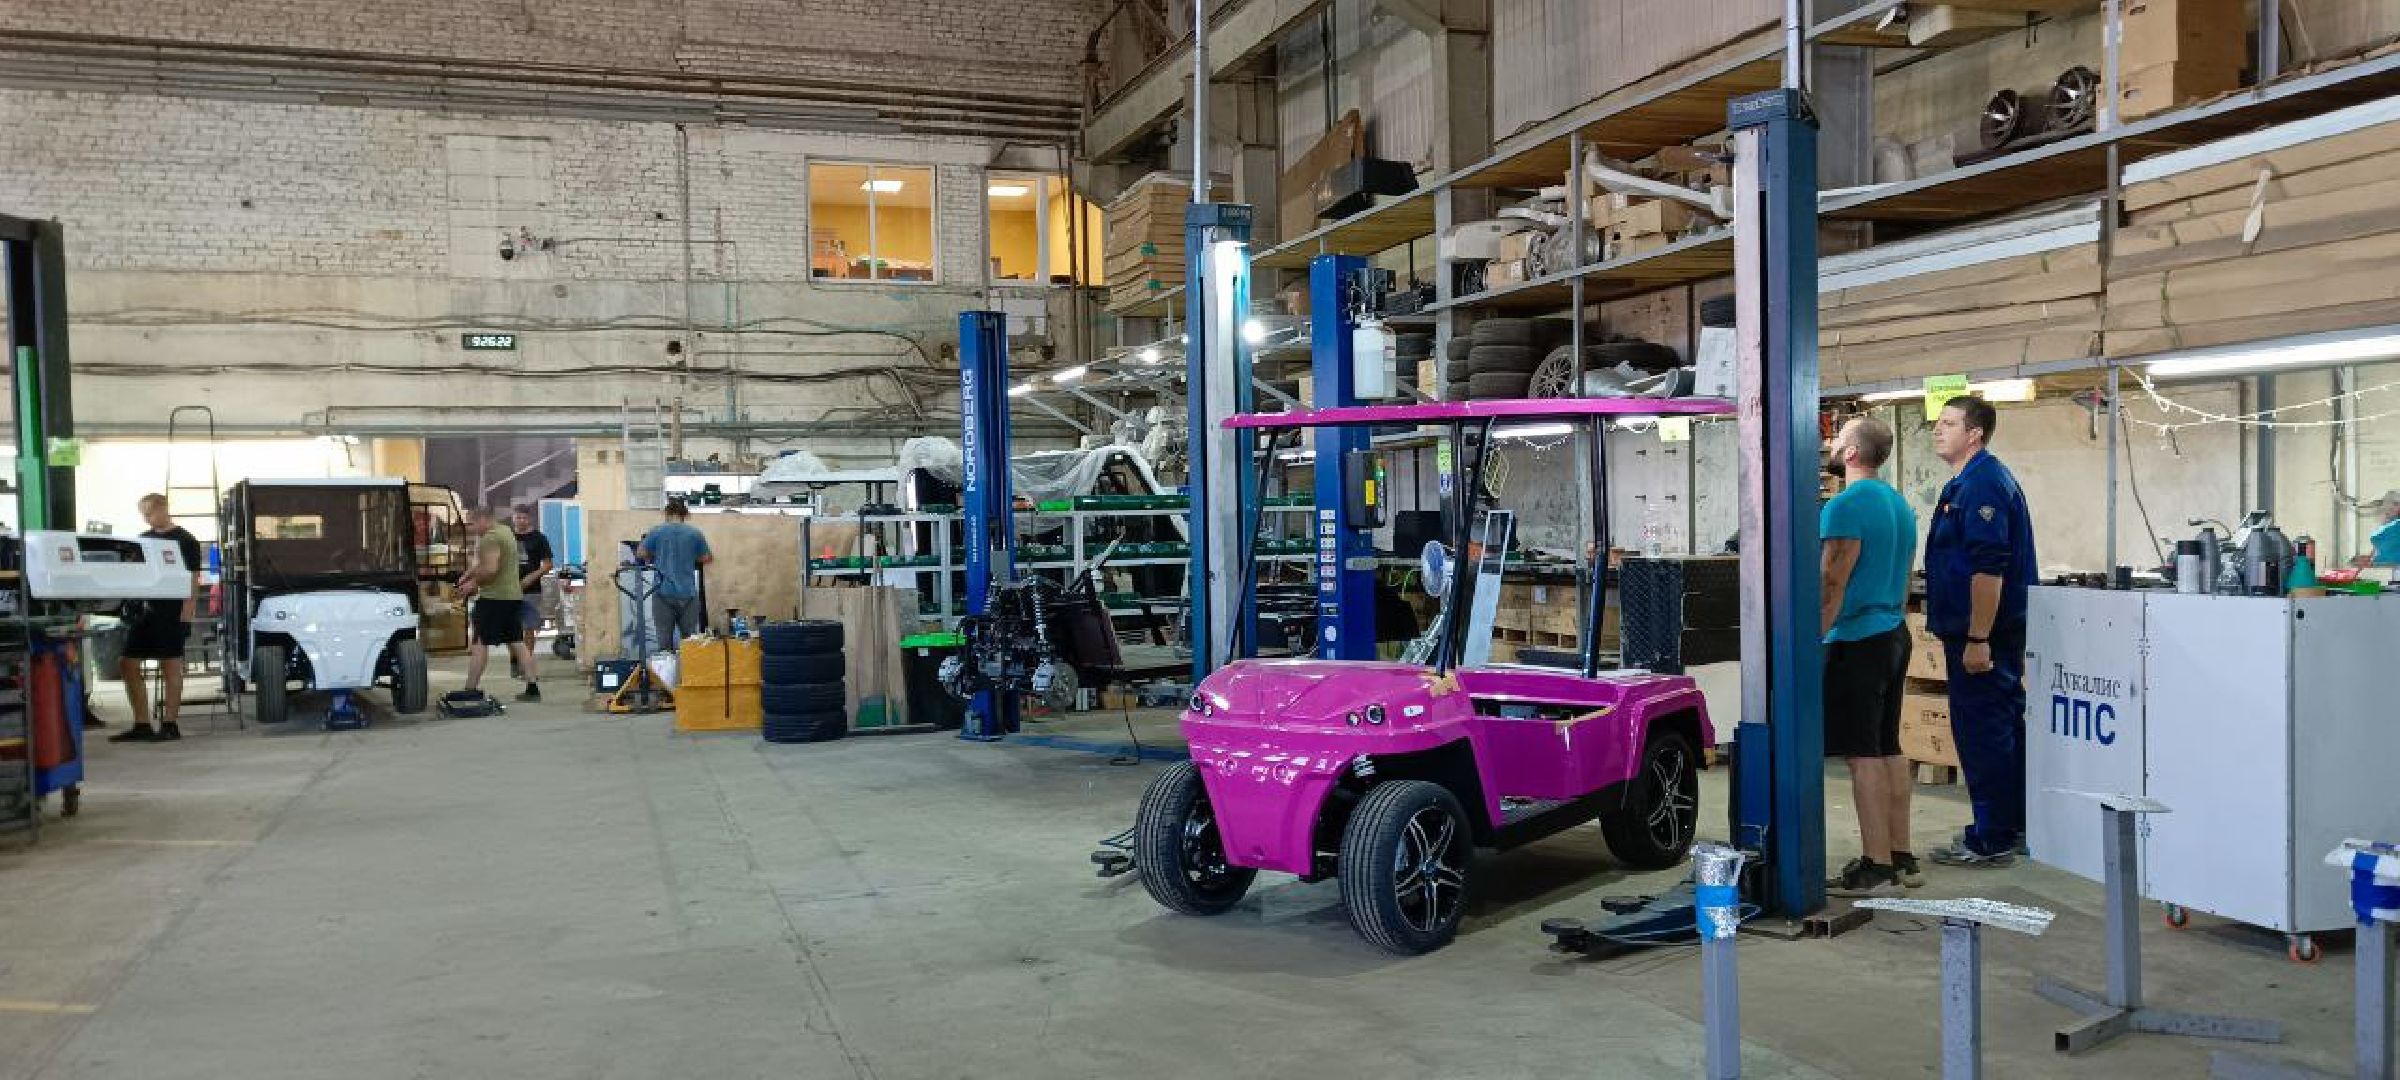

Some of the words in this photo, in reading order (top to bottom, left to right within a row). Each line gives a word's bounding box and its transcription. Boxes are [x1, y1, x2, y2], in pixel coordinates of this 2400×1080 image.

[962, 368, 976, 491] NORDBERG
[2051, 662, 2121, 699] Дукалис
[2051, 694, 2116, 746] ППС
